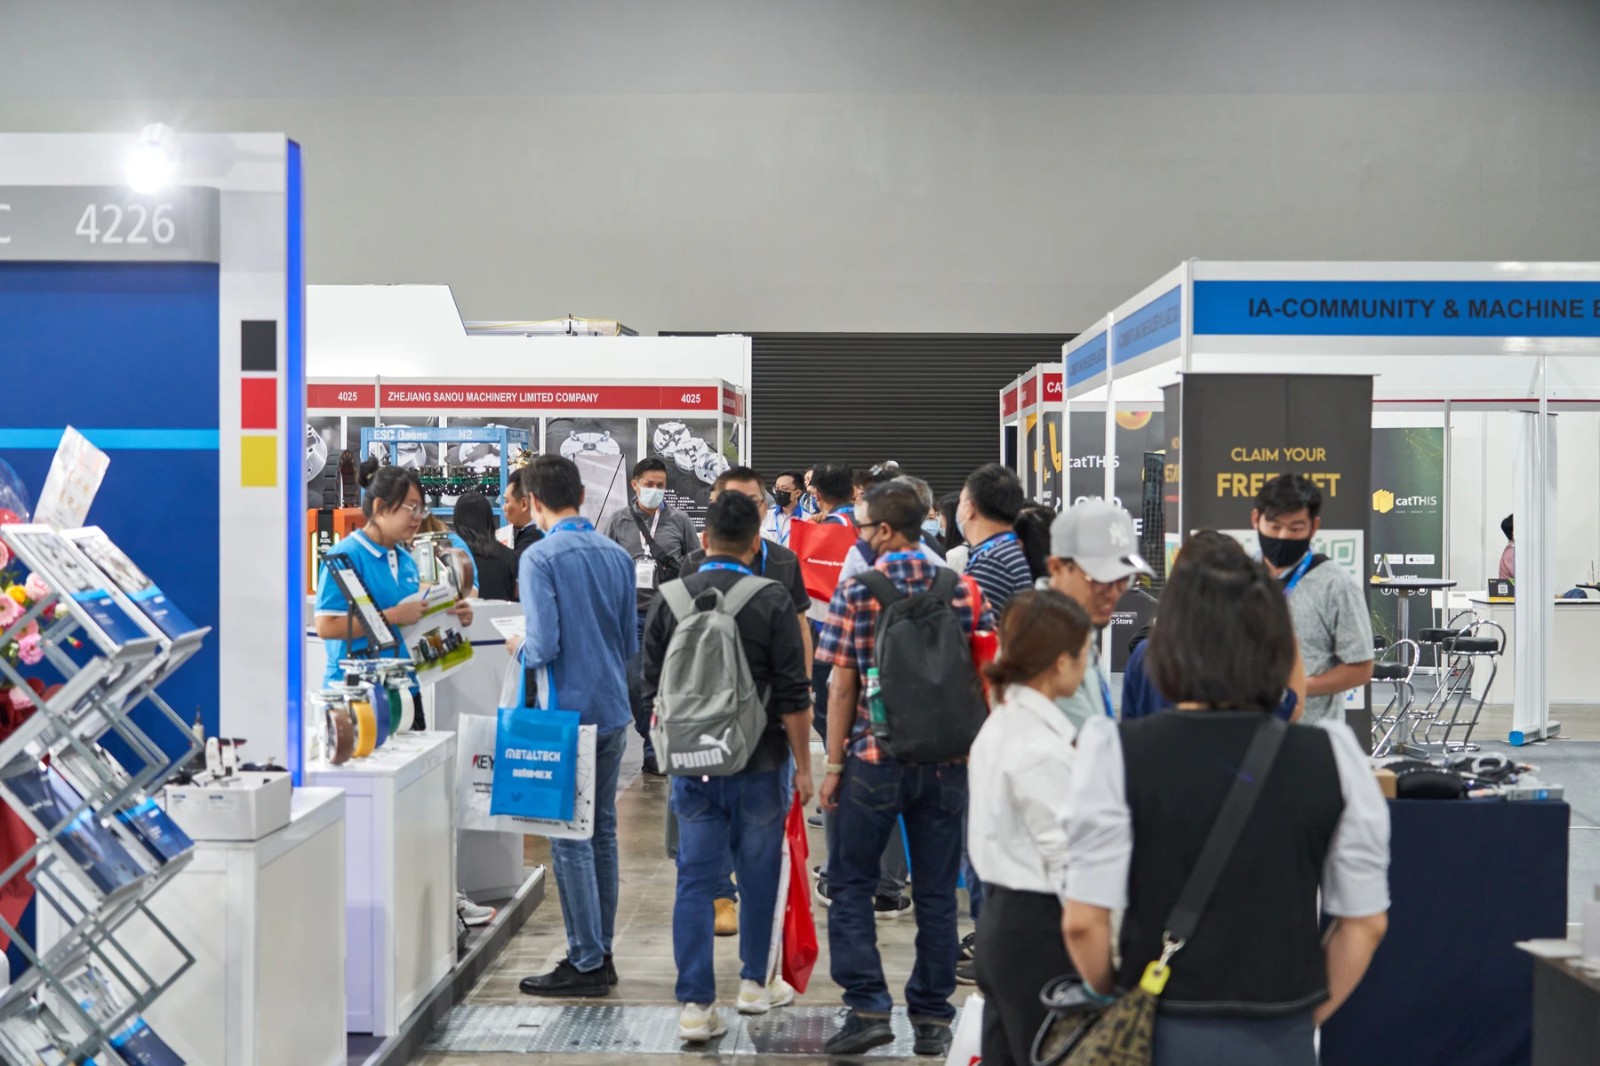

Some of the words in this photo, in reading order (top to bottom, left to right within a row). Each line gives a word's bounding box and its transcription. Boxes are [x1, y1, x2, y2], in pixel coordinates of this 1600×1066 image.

[75, 204, 176, 244] 4226
[1248, 298, 1435, 318] IA-COMMUNITY
[1443, 299, 1460, 318] &
[1468, 299, 1584, 318] MACHINE
[1046, 381, 1063, 393] CA
[337, 392, 358, 401] 4025
[388, 391, 431, 402] ZHEJIANG
[433, 392, 464, 402] SANOU
[466, 392, 517, 402] MACHINERY
[519, 392, 554, 403] LIMITED
[555, 392, 599, 403] COMPANY
[681, 393, 701, 404] 4025
[1230, 447, 1280, 462] CLAIM
[1283, 447, 1327, 462] YOUR
[1216, 472, 1281, 498] FRE
[1395, 495, 1437, 507] catTHIS
[671, 747, 724, 769] PUMA
